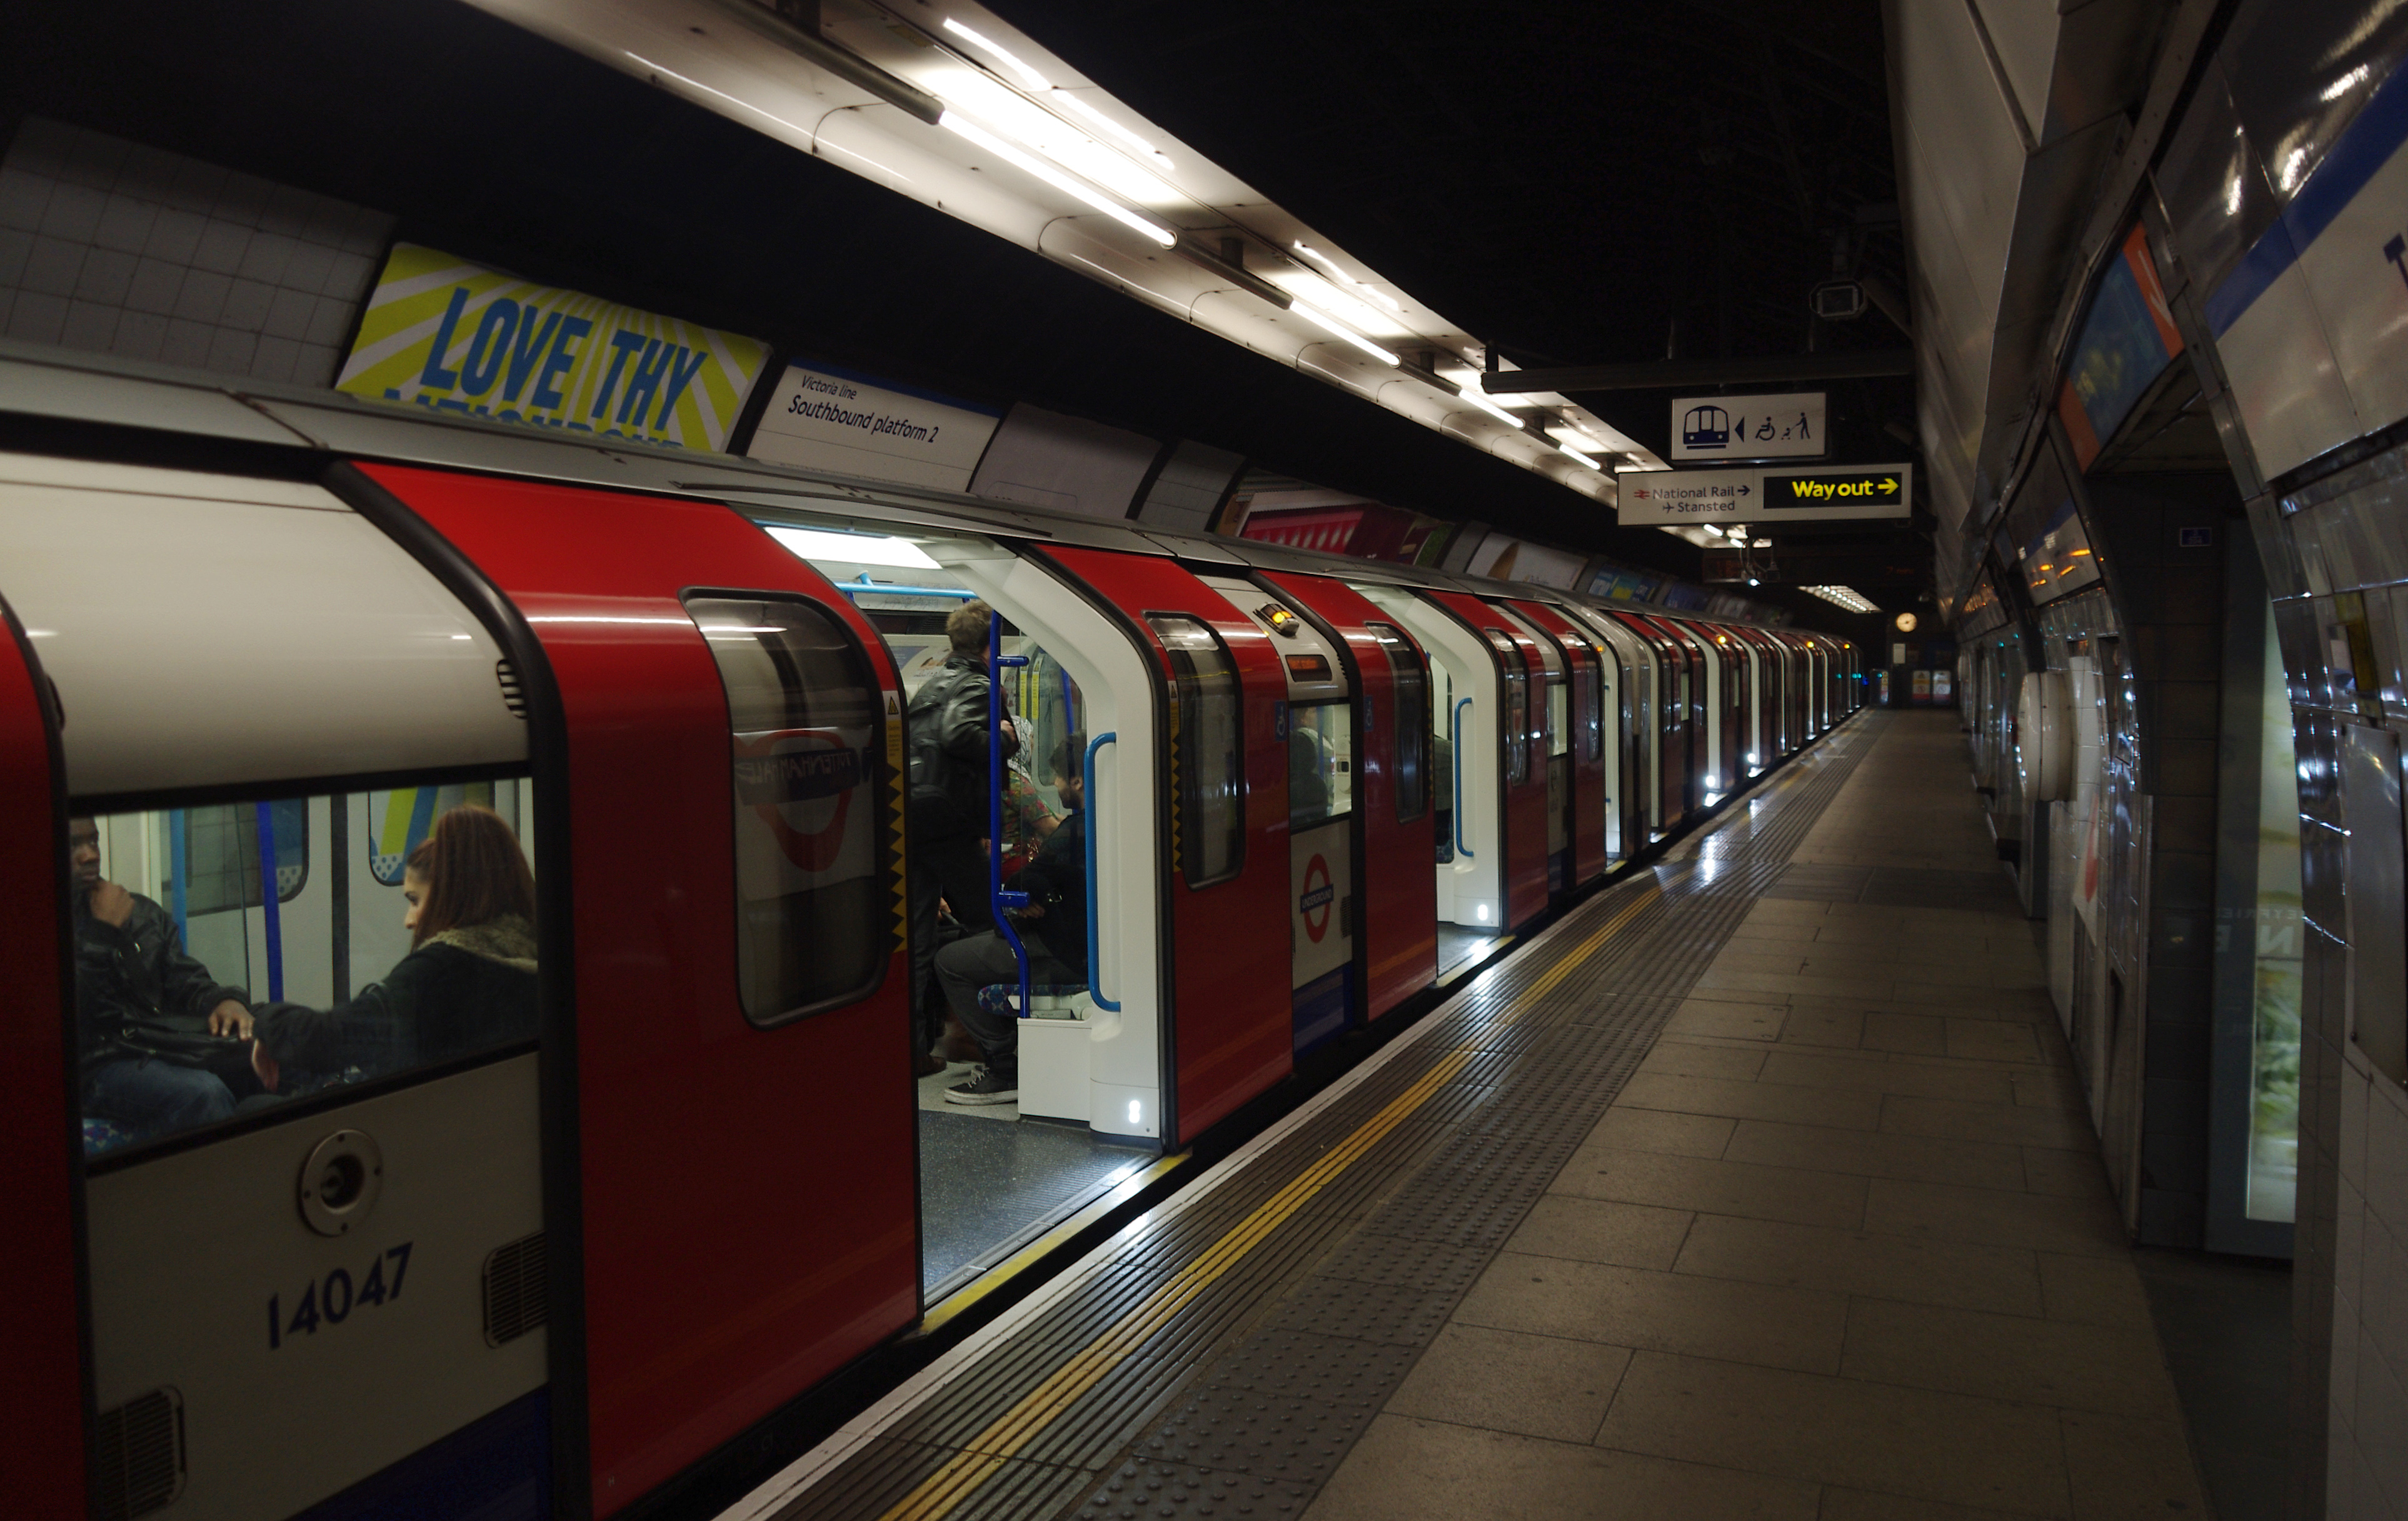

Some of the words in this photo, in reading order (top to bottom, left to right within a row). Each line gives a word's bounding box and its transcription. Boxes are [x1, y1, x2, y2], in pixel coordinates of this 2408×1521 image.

[419, 288, 593, 409] LOVE
[591, 329, 708, 431] THY
[801, 375, 839, 395] Victoria
[840, 385, 857, 400] line
[788, 394, 875, 429] Southbound
[871, 415, 927, 441] platform
[928, 426, 939, 443] 2
[1653, 487, 1707, 499] National
[1712, 486, 1735, 497] Rail
[1792, 479, 1835, 502] Way
[1838, 479, 1874, 497] out
[1678, 501, 1735, 512] Stansted
[268, 1240, 413, 1349] 14047
